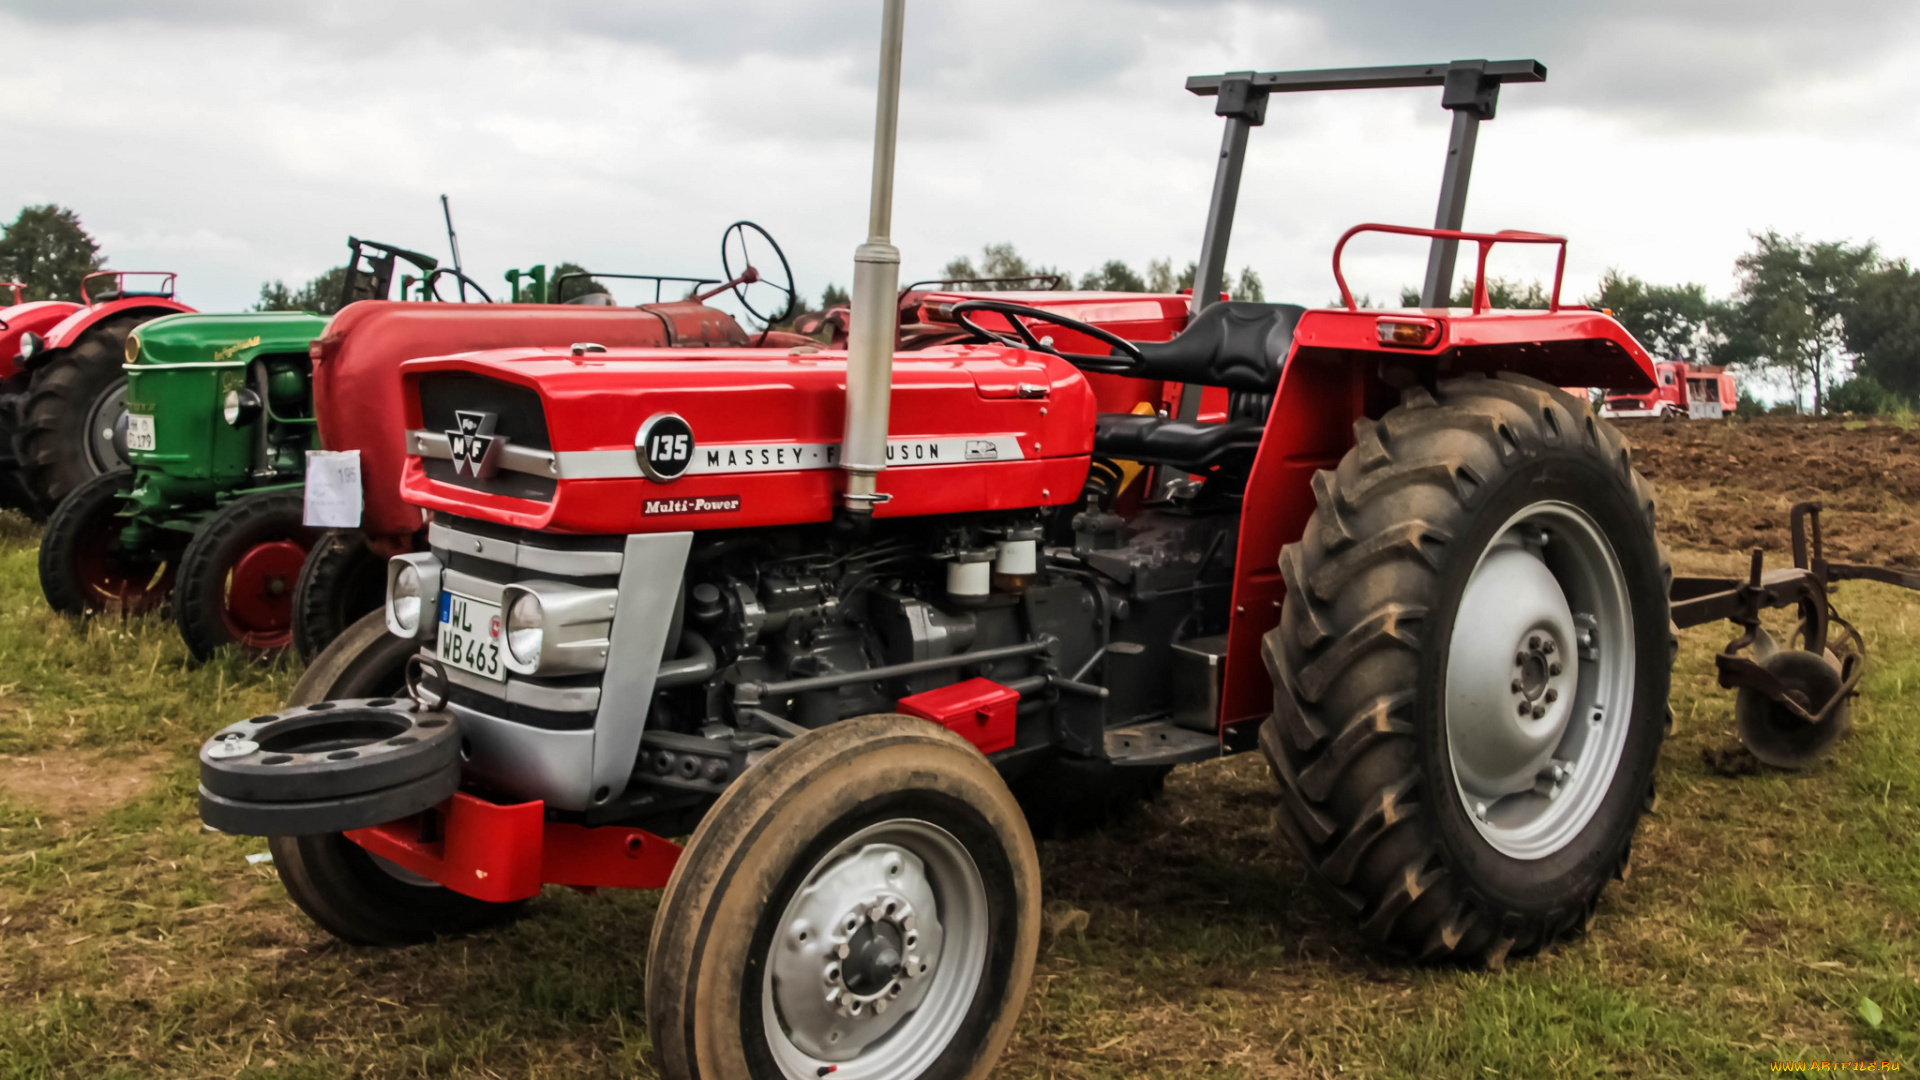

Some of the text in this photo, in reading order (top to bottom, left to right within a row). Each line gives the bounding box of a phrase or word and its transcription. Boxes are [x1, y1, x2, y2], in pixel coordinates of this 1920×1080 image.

[650, 434, 689, 461] 135
[644, 498, 740, 515] Multi-Power
[452, 599, 472, 632] WL
[443, 630, 499, 675] WB 463
